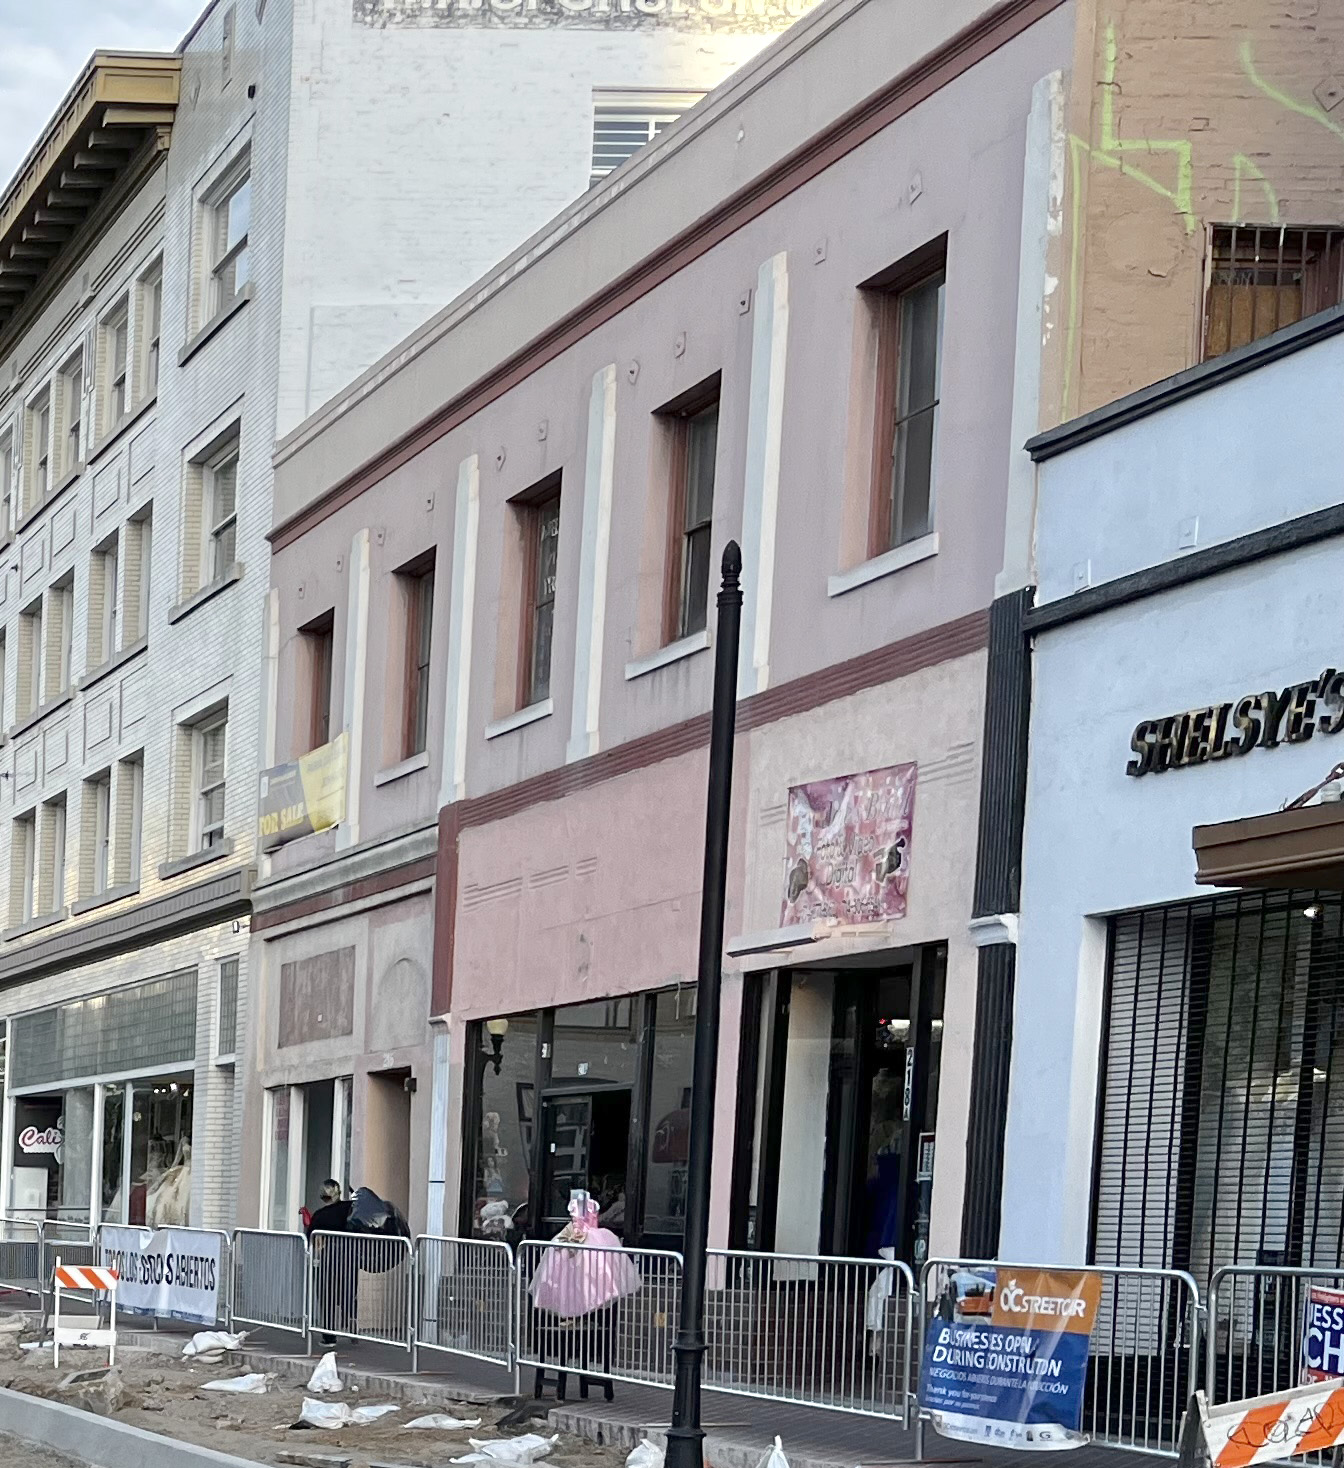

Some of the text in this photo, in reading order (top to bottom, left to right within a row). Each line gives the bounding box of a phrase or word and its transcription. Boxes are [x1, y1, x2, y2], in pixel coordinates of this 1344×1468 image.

[1126, 669, 1344, 777] SHELSYE'S
[259, 802, 304, 835] FOR SALE
[175, 1253, 216, 1291] ABIERTOS
[933, 1346, 984, 1368] DURING
